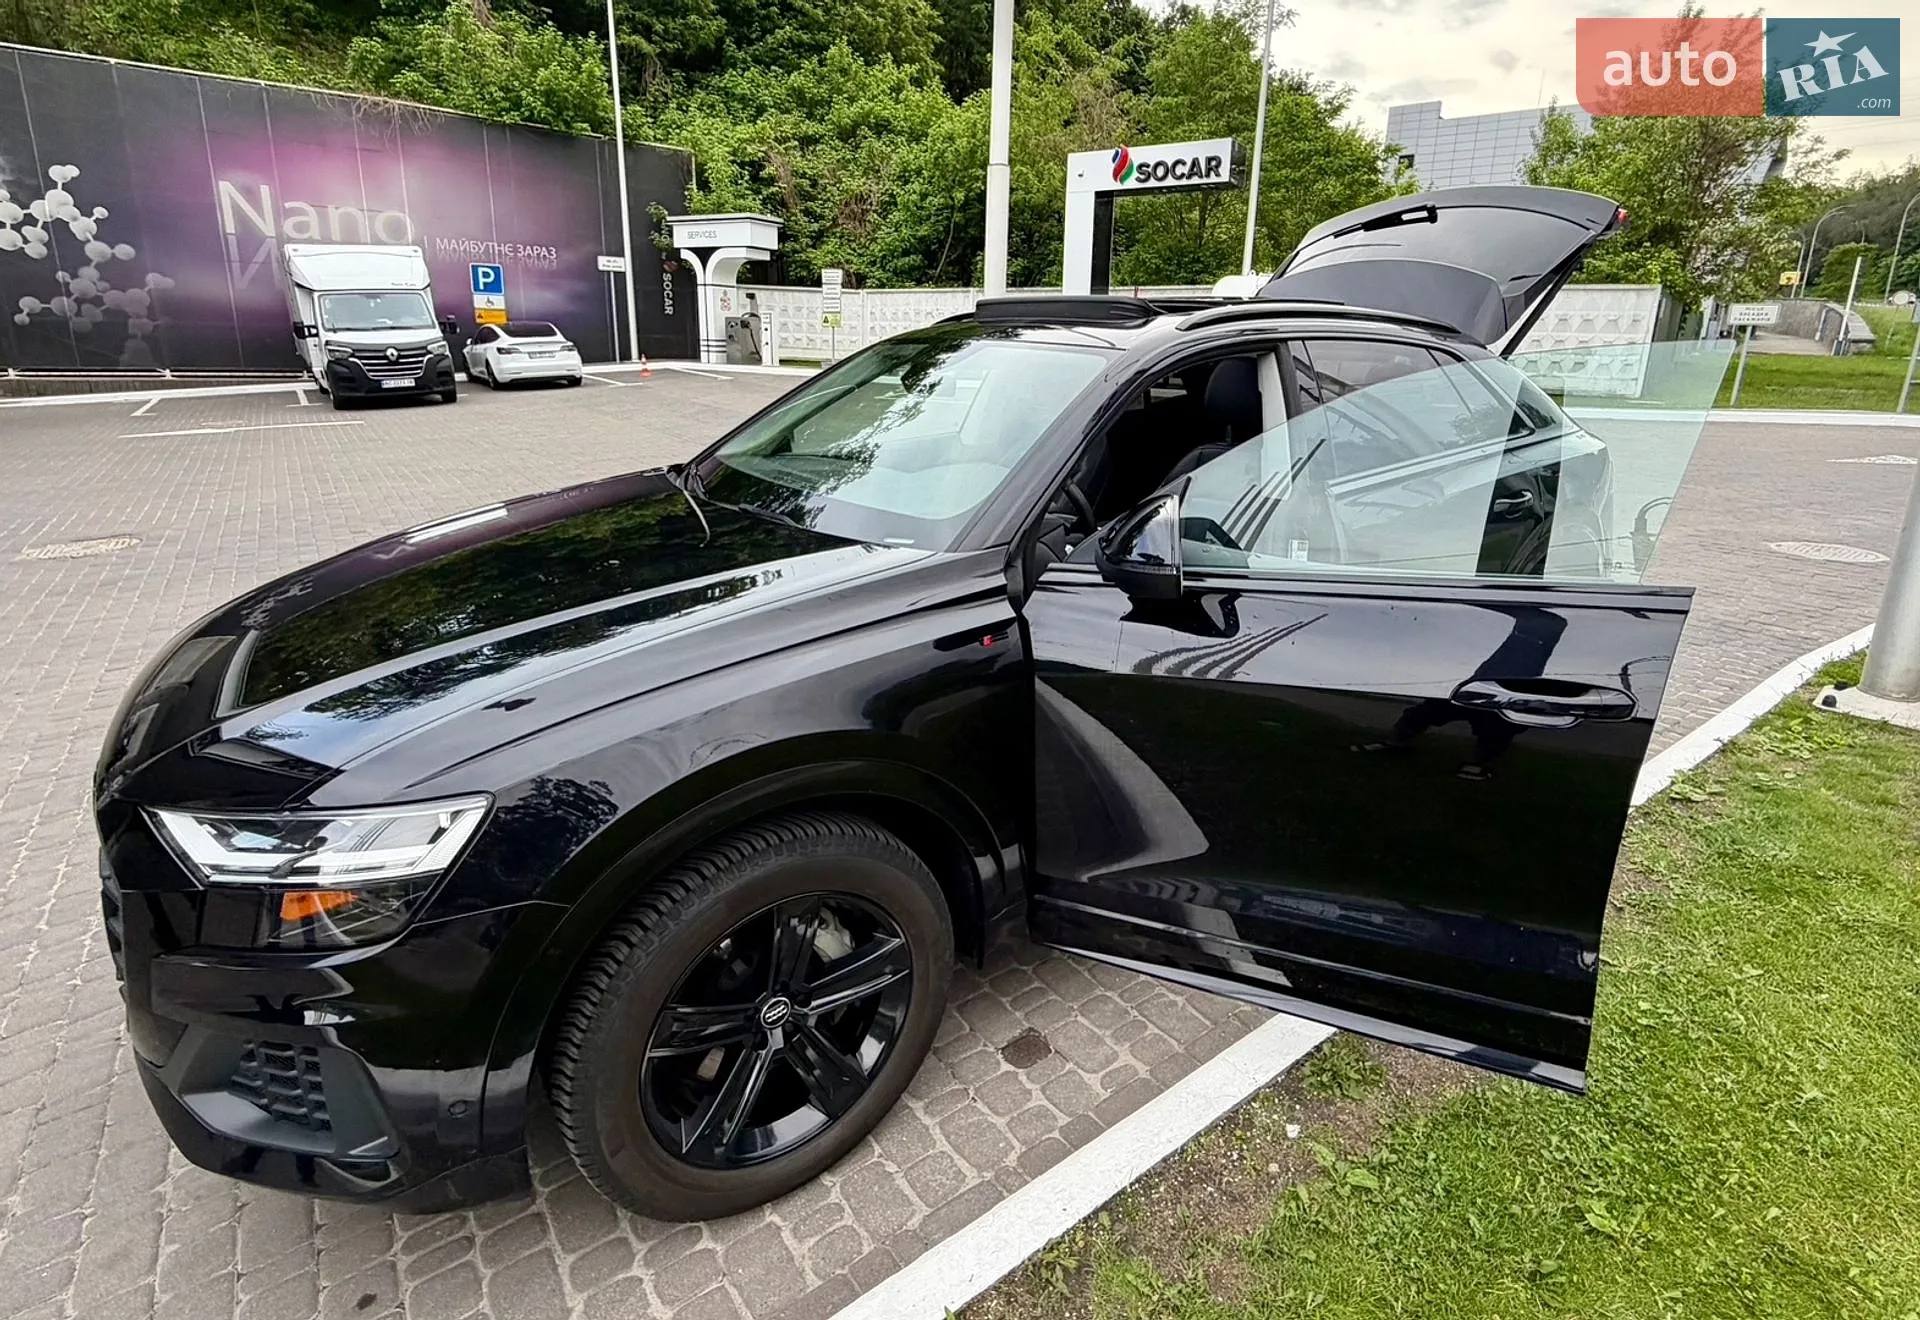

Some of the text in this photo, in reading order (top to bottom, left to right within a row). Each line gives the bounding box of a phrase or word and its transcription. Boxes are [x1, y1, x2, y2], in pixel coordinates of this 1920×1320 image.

[1135, 155, 1222, 183] SOCAR
[218, 180, 414, 244] Nano
[436, 238, 557, 259] МАЙБУТНЄ ЗАРАЗ
[477, 267, 495, 290] P
[662, 273, 674, 315] SOCAR
